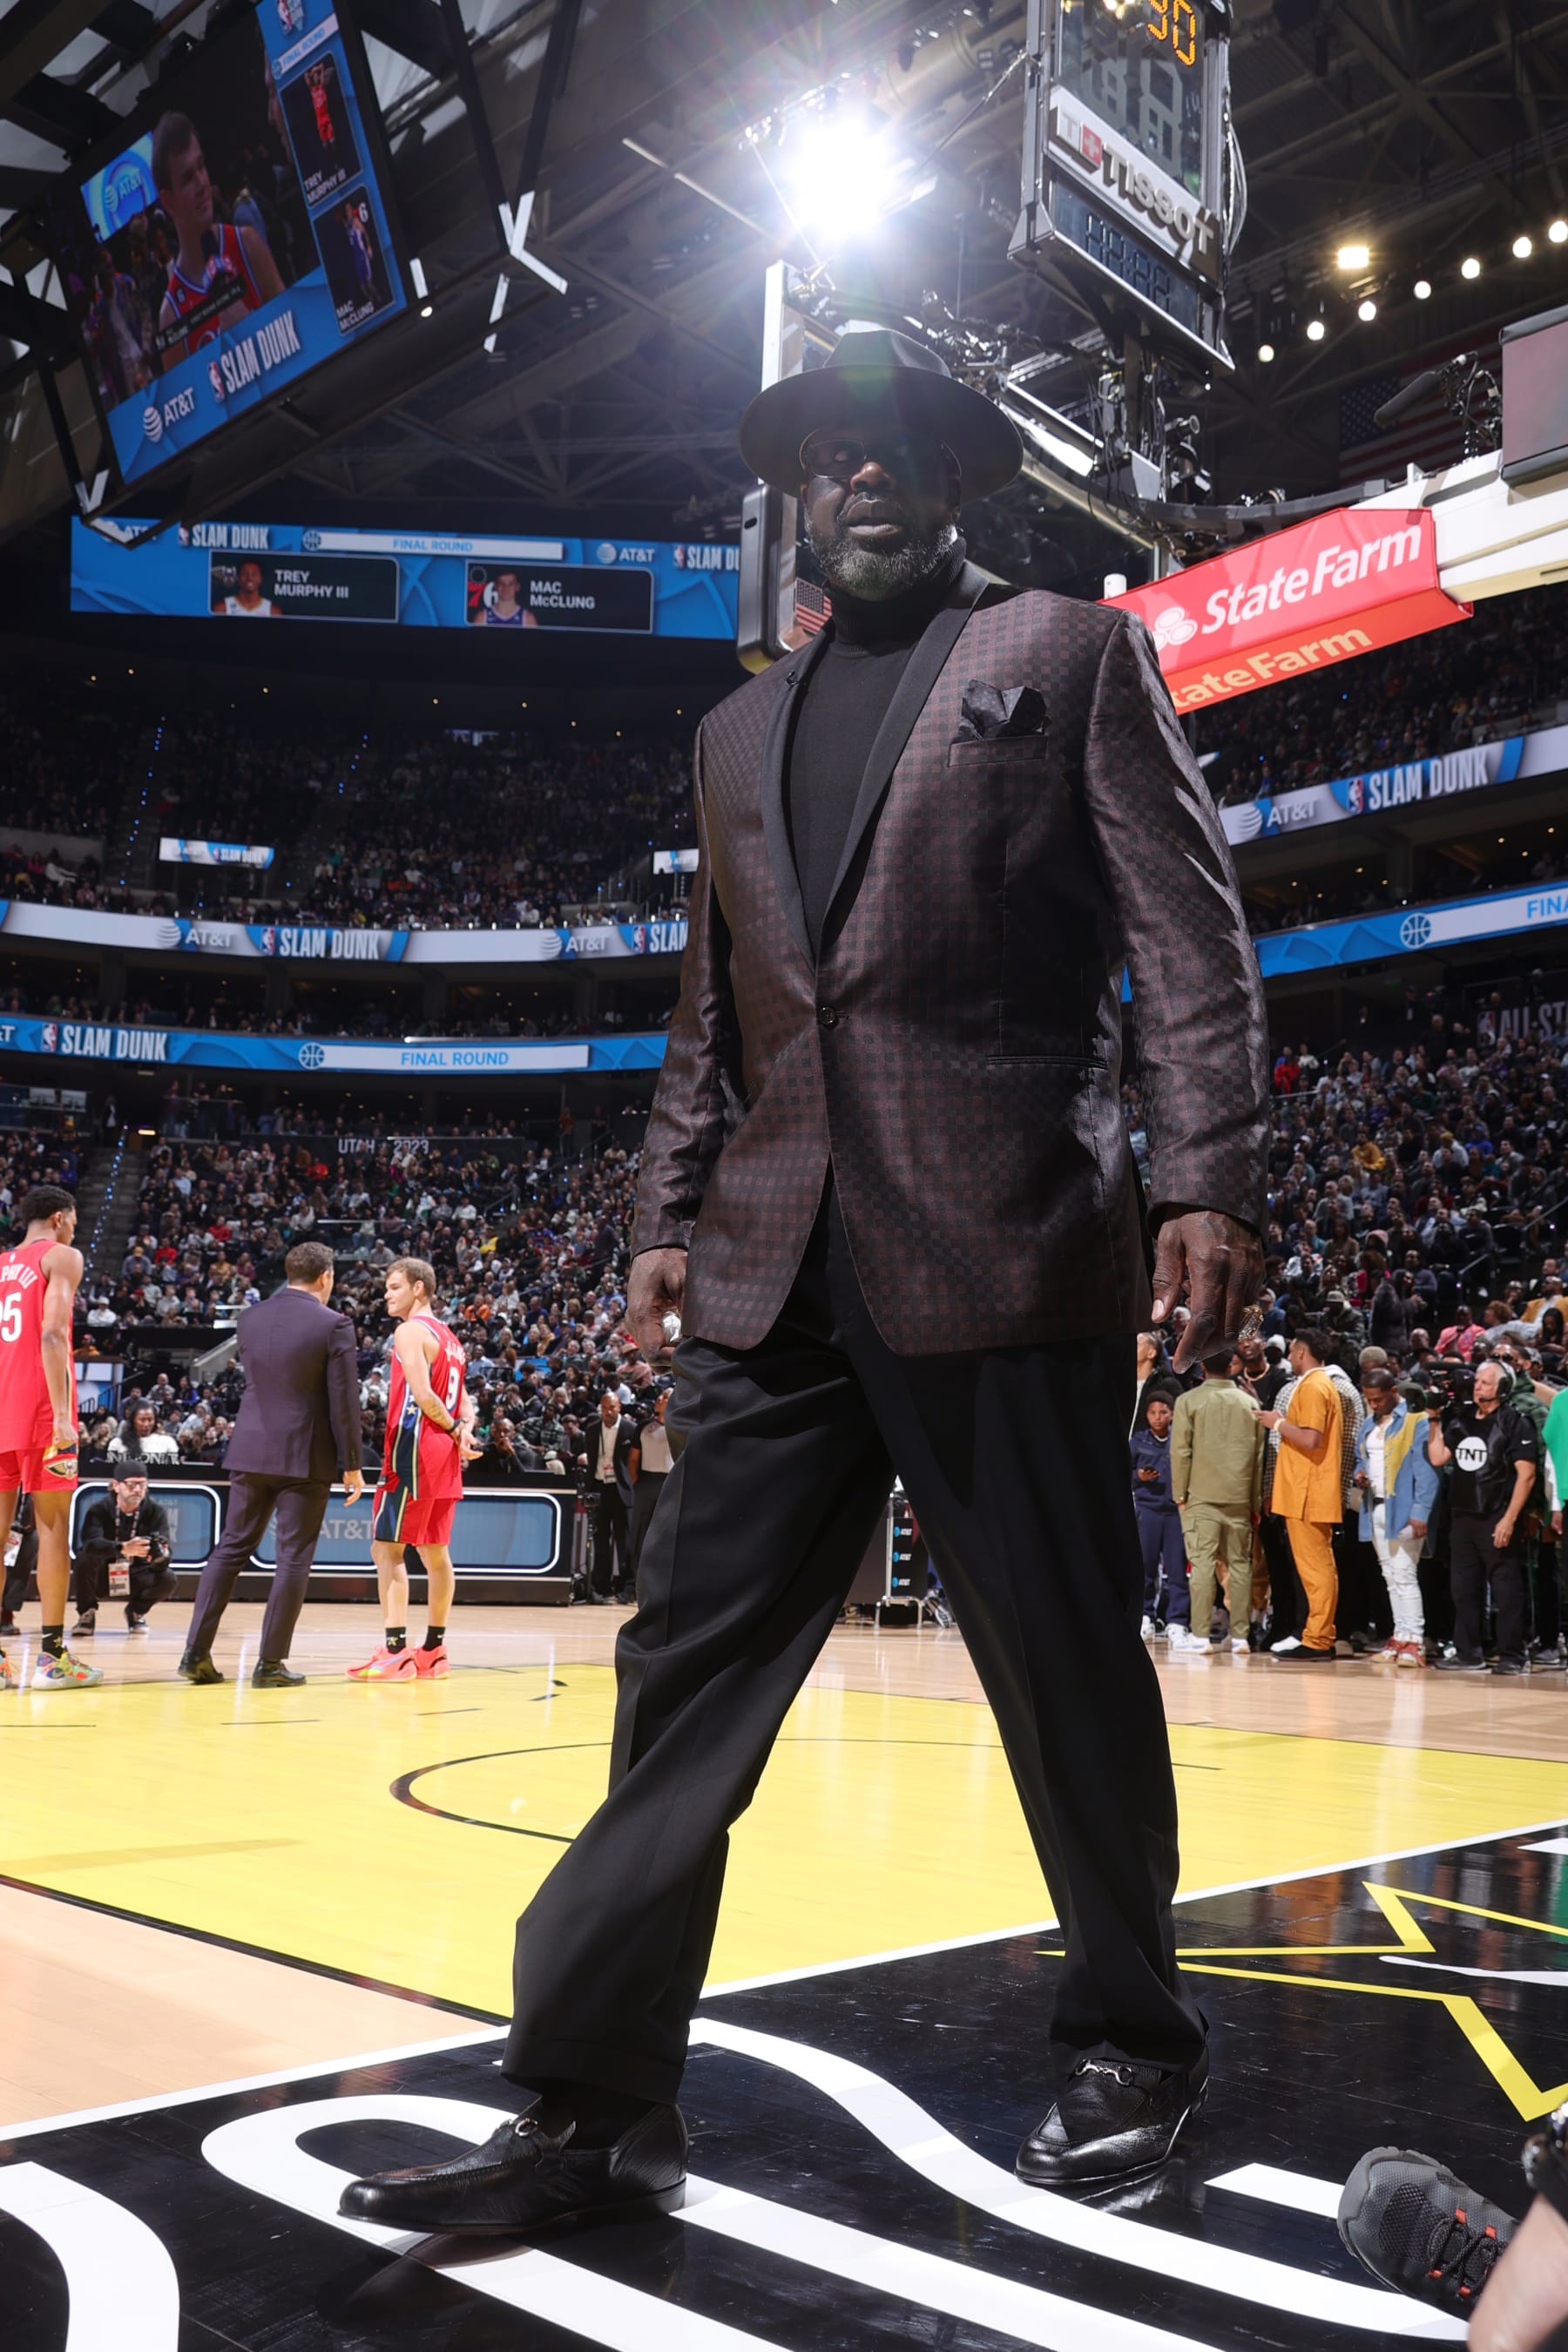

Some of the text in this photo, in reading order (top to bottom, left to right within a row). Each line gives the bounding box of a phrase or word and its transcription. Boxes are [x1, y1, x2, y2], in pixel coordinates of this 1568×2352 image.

[304, 170, 323, 190] TREY
[307, 175, 337, 204] MURPHY
[1103, 143, 1214, 254] TISSOT
[336, 300, 354, 319] MAC
[220, 337, 260, 394] SLAM
[256, 309, 301, 371] DUNK
[163, 387, 195, 427] AT&T
[192, 524, 269, 550] SLAM DUNK
[393, 538, 473, 552] FINAL ROUND
[619, 548, 655, 563] AT&T
[686, 545, 722, 571] SLAM
[274, 568, 310, 583] TREY
[274, 584, 349, 598] MURPHY III
[530, 579, 562, 594] MAC
[530, 594, 595, 609] McCLUNG
[1369, 747, 1489, 811] SLAM DUNK
[1266, 799, 1319, 828] AT&T
[185, 928, 233, 947] AT&T
[279, 928, 380, 960] SLAM DUNK
[566, 935, 610, 952] AT&T
[61, 1024, 167, 1061] SLAM DUNK
[401, 1051, 509, 1066] FINAL ROUND
[338, 1138, 429, 1155] UTAH 2023
[0, 1291, 22, 1342] 5
[446, 1365, 460, 1411] 9
[1456, 1448, 1488, 1463] TNT
